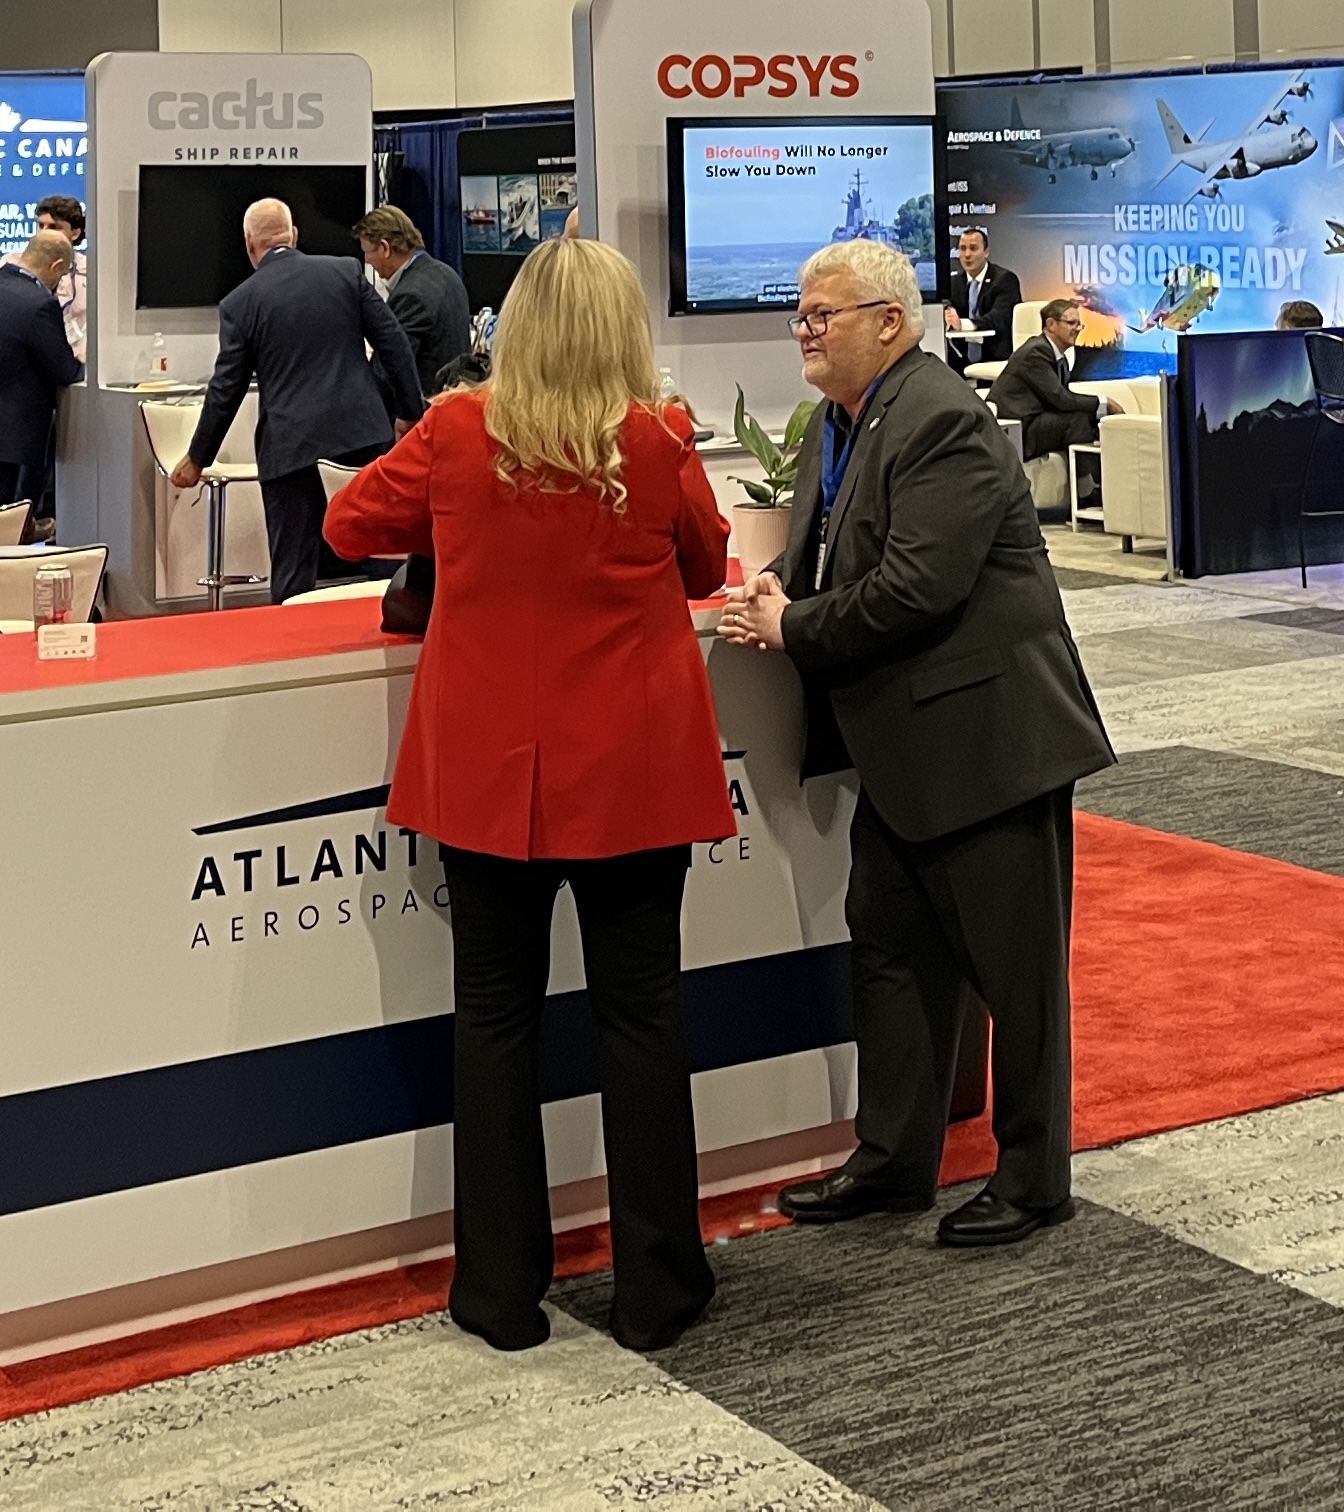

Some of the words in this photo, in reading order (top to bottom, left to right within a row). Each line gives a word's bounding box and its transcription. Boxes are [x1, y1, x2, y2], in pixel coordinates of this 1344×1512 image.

[657, 53, 860, 99] COPSYS
[147, 78, 324, 130] cactus
[174, 147, 220, 160] SHIP
[229, 146, 299, 160] REPAIR
[706, 144, 780, 160] Biofouling
[785, 144, 813, 157] Will
[818, 146, 836, 157] No
[840, 145, 889, 159] Longer
[12, 164, 23, 176] &
[706, 165, 741, 177] Slow
[744, 164, 771, 176] You
[776, 164, 816, 176] Down
[1114, 205, 1198, 232] KEEPING
[1204, 204, 1245, 231] YOU
[1064, 244, 1189, 285] MISSION
[1200, 245, 1308, 291] READY
[191, 827, 446, 901] ATLANT
